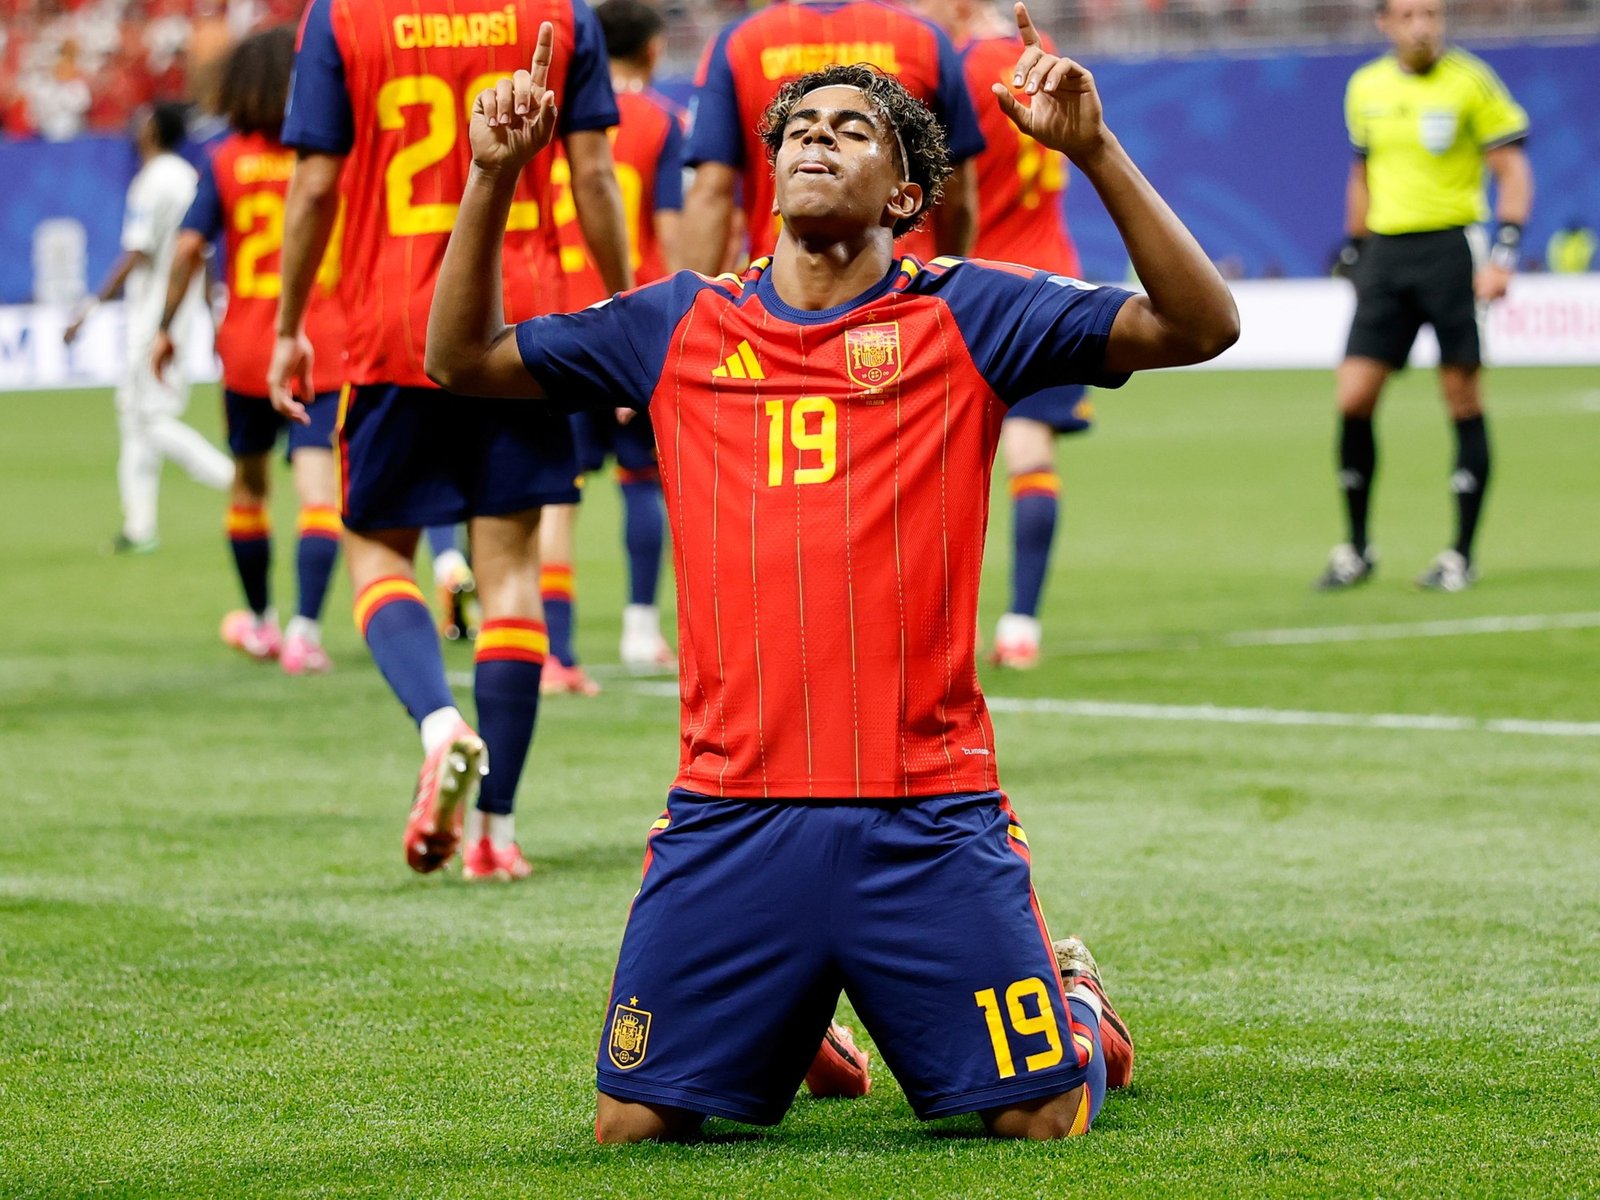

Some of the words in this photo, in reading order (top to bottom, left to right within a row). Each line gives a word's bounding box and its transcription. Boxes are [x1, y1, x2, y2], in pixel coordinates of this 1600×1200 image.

[393, 4, 518, 49] CUBARSÍ
[765, 396, 837, 487] 19
[974, 977, 1064, 1080] 19
